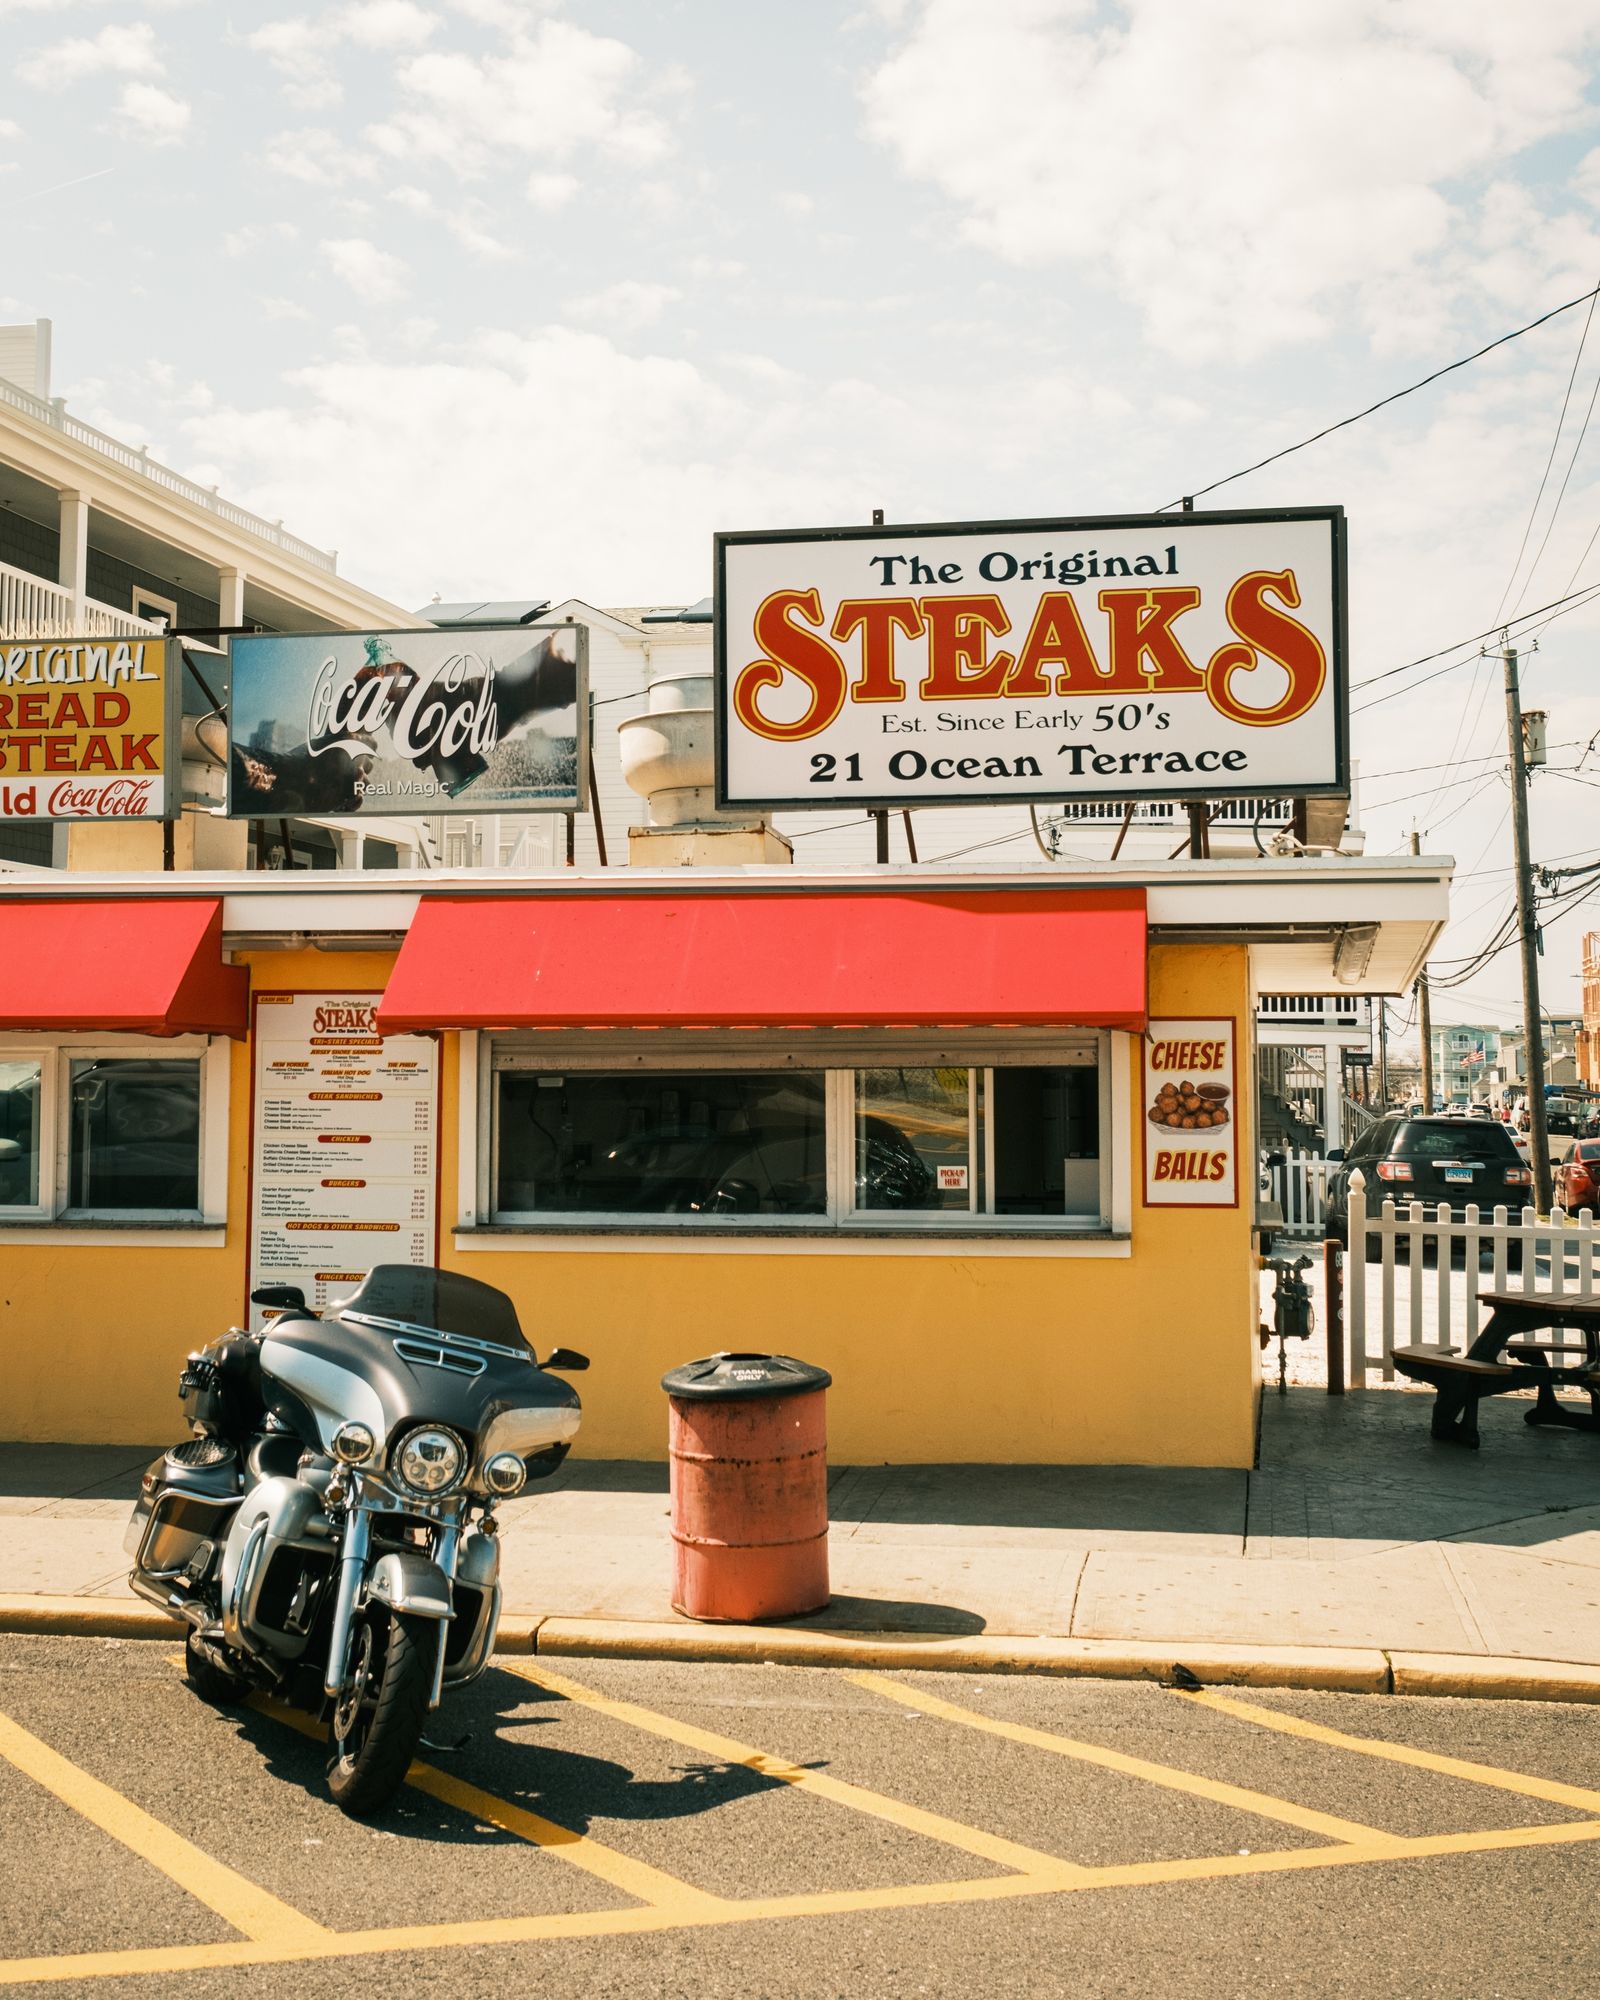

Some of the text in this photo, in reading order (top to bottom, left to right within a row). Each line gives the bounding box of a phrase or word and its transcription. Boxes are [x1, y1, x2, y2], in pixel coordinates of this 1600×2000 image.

[869, 546, 1180, 587] The Original
[734, 569, 1327, 743] STEAKS
[308, 650, 498, 760] Coca-Cola
[880, 704, 1172, 734] Est. Since Early 50's
[809, 744, 1249, 784] 21 Ocean Terrace
[48, 780, 154, 816] Coca-Cola
[354, 779, 450, 798] Real Magic
[1151, 1041, 1226, 1071] CHEESE
[1153, 1151, 1228, 1181] BALLS
